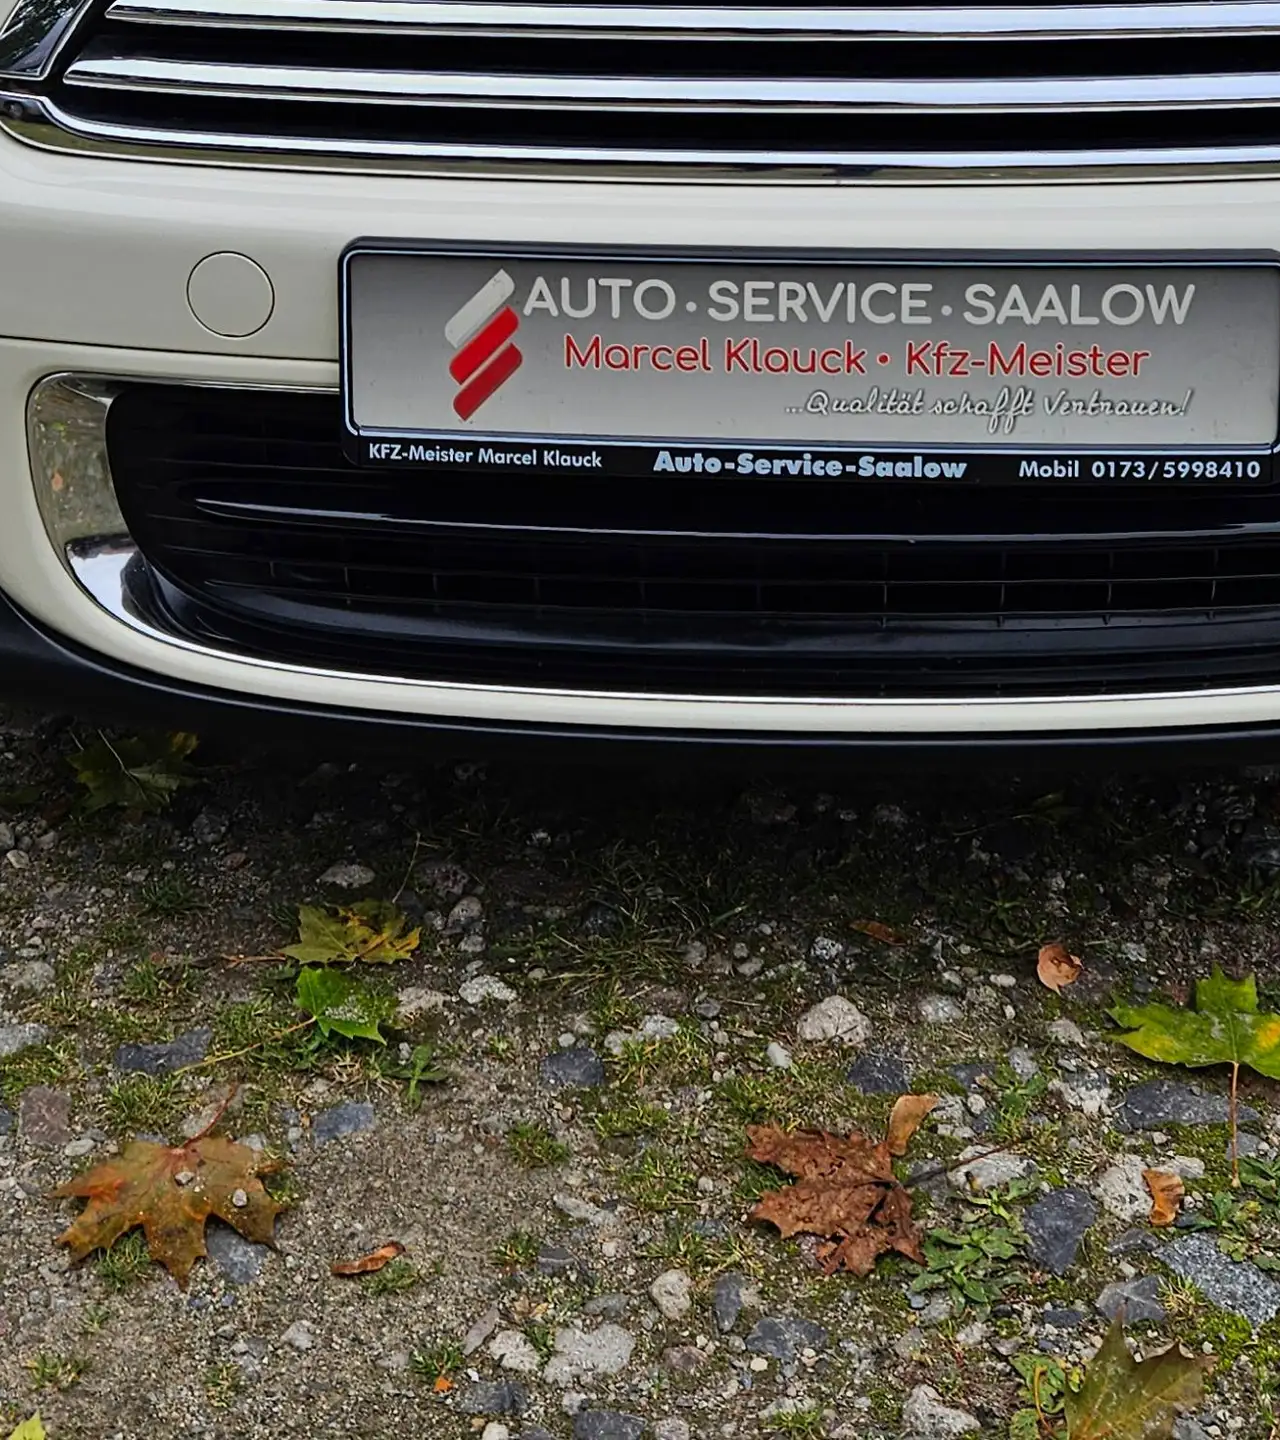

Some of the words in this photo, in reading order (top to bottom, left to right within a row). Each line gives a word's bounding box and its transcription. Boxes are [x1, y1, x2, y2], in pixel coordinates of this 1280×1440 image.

[563, 333, 712, 373] Marcel
[724, 338, 867, 375] Klauck
[906, 340, 1151, 377] Kfz-Meister
[928, 387, 1035, 434] schafft
[1042, 387, 1194, 418] Vertrauen!
[369, 443, 473, 464] KFZ-Meister
[478, 448, 537, 466] Marcel
[543, 450, 603, 468] Klauck
[653, 451, 967, 479] Auto-Service-Saalow
[1018, 460, 1080, 480] Mobil
[1091, 460, 1261, 481] 0173/5998410
